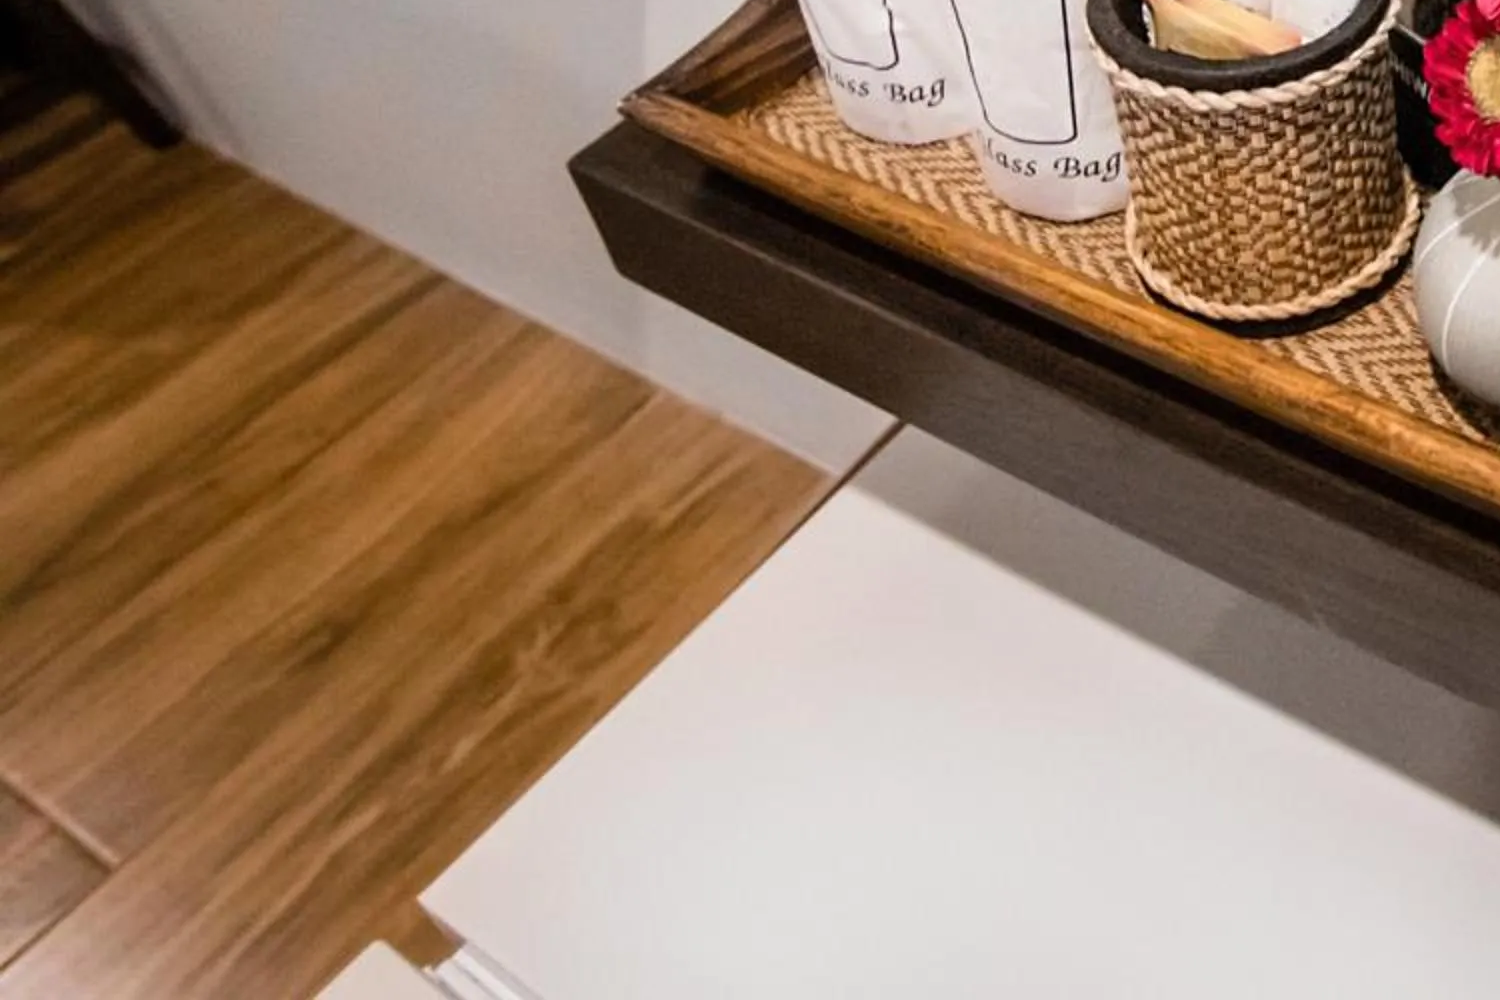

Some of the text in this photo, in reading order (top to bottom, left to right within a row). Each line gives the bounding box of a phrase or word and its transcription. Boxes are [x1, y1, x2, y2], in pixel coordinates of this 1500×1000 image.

[826, 61, 946, 107] lass Bag
[985, 136, 1122, 182] lass Bag
